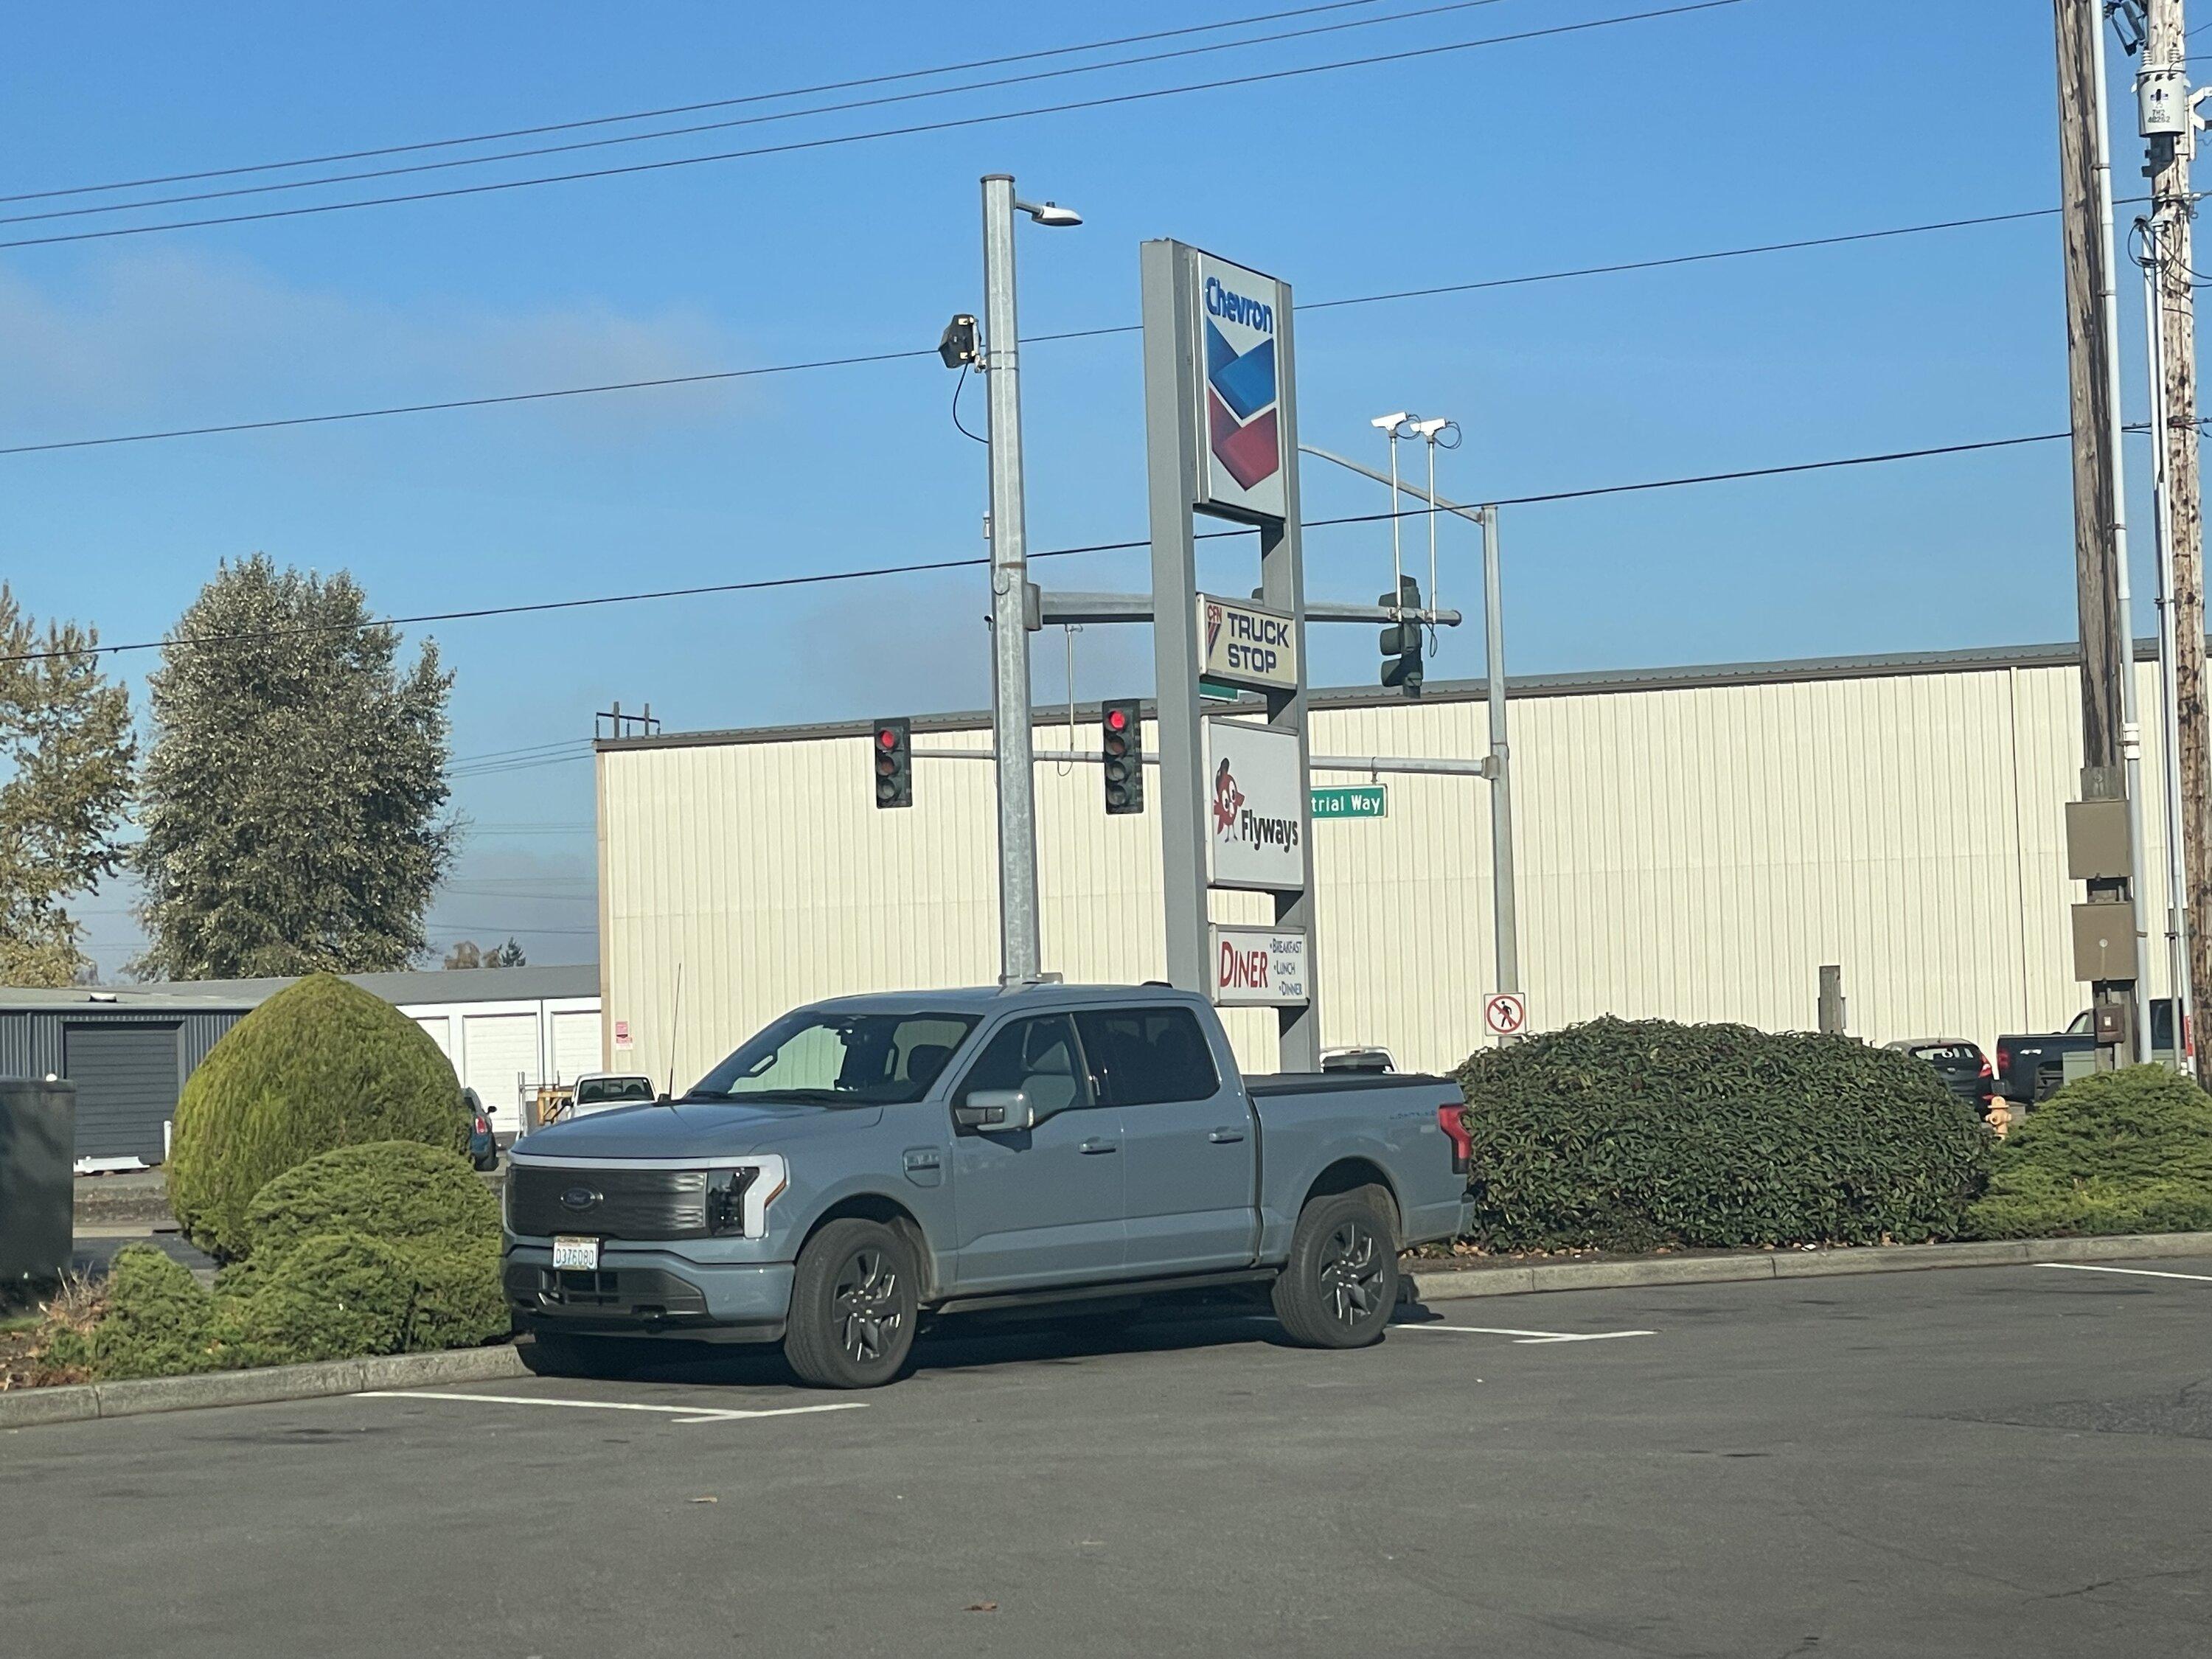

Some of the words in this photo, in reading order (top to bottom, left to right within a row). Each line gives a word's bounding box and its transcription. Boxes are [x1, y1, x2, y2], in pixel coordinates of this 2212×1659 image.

[1206, 276, 1273, 334] Chevron
[1228, 612, 1290, 648] TRUCK
[1228, 643, 1277, 674] STOP
[1351, 794, 1380, 815] Way
[1241, 809, 1298, 854] Flyways
[1220, 941, 1268, 988] DINER
[1276, 960, 1295, 975] LUNCH
[1281, 981, 1303, 996] DINNER
